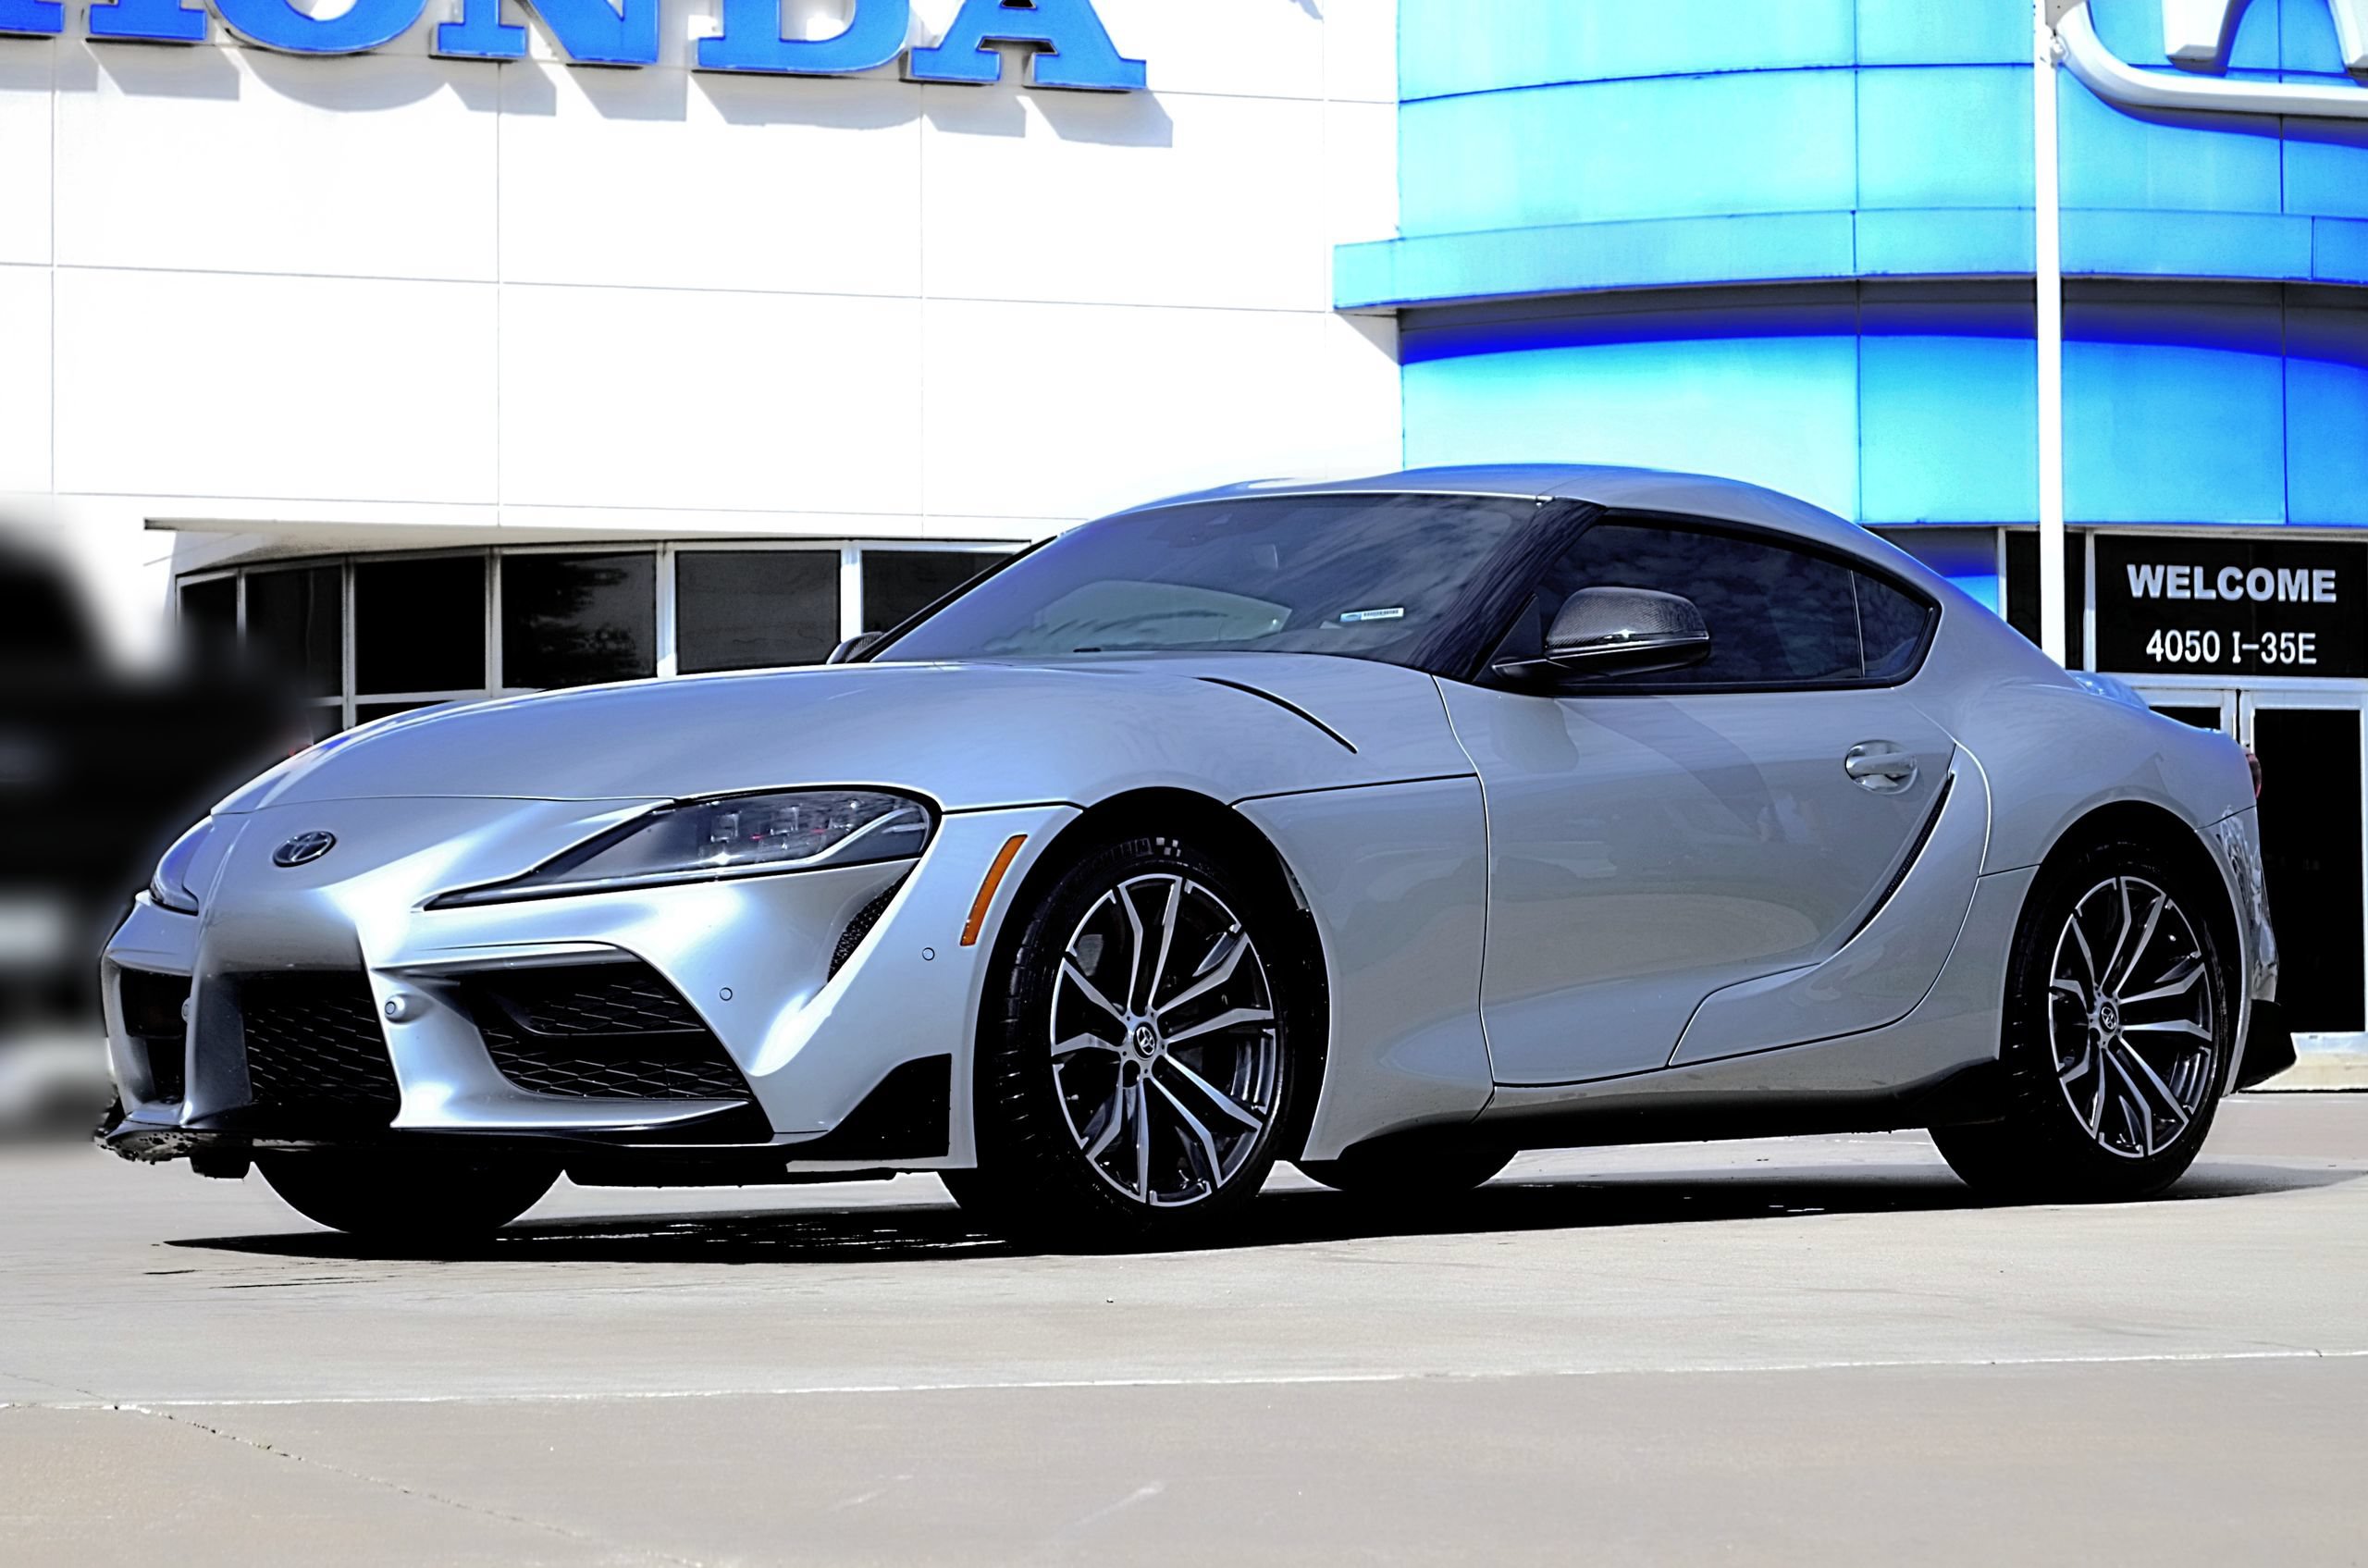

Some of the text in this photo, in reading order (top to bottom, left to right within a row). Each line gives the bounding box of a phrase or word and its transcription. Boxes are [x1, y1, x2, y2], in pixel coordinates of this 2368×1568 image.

[2127, 564, 2337, 602] WELCOME
[2146, 629, 2318, 664] 4050 I-35E
